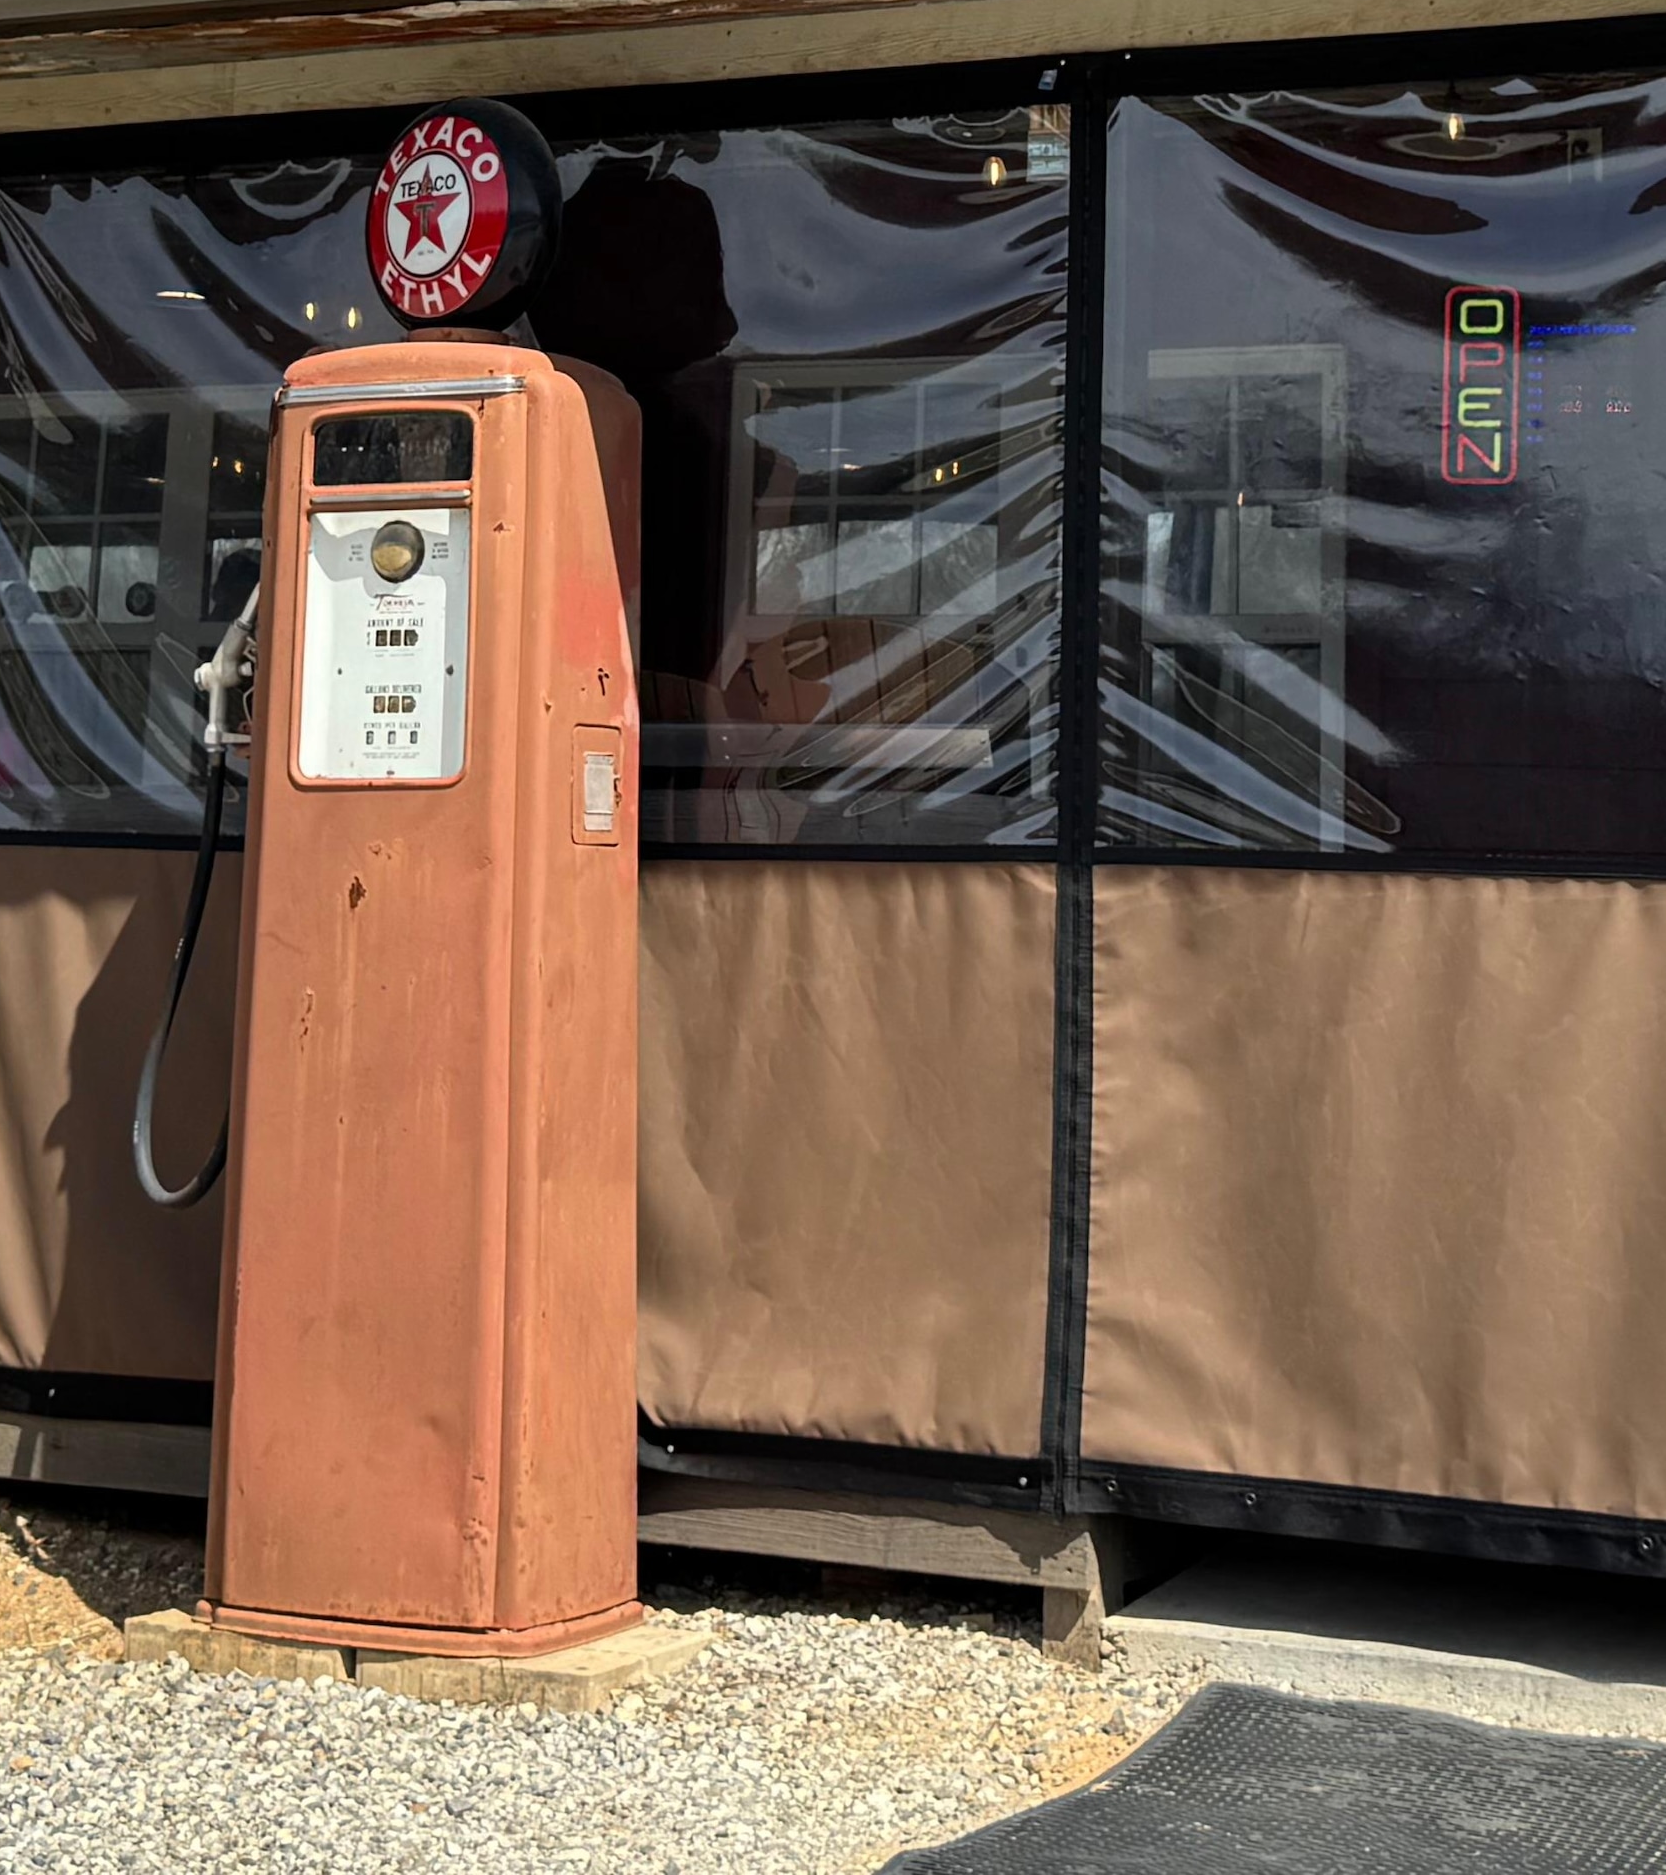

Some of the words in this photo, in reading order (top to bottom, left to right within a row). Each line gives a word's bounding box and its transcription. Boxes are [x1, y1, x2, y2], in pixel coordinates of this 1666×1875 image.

[374, 116, 500, 197] TEXACO
[401, 173, 457, 198] TEXACO
[380, 252, 493, 315] ETHYL
[1457, 298, 1505, 473] OPEN
